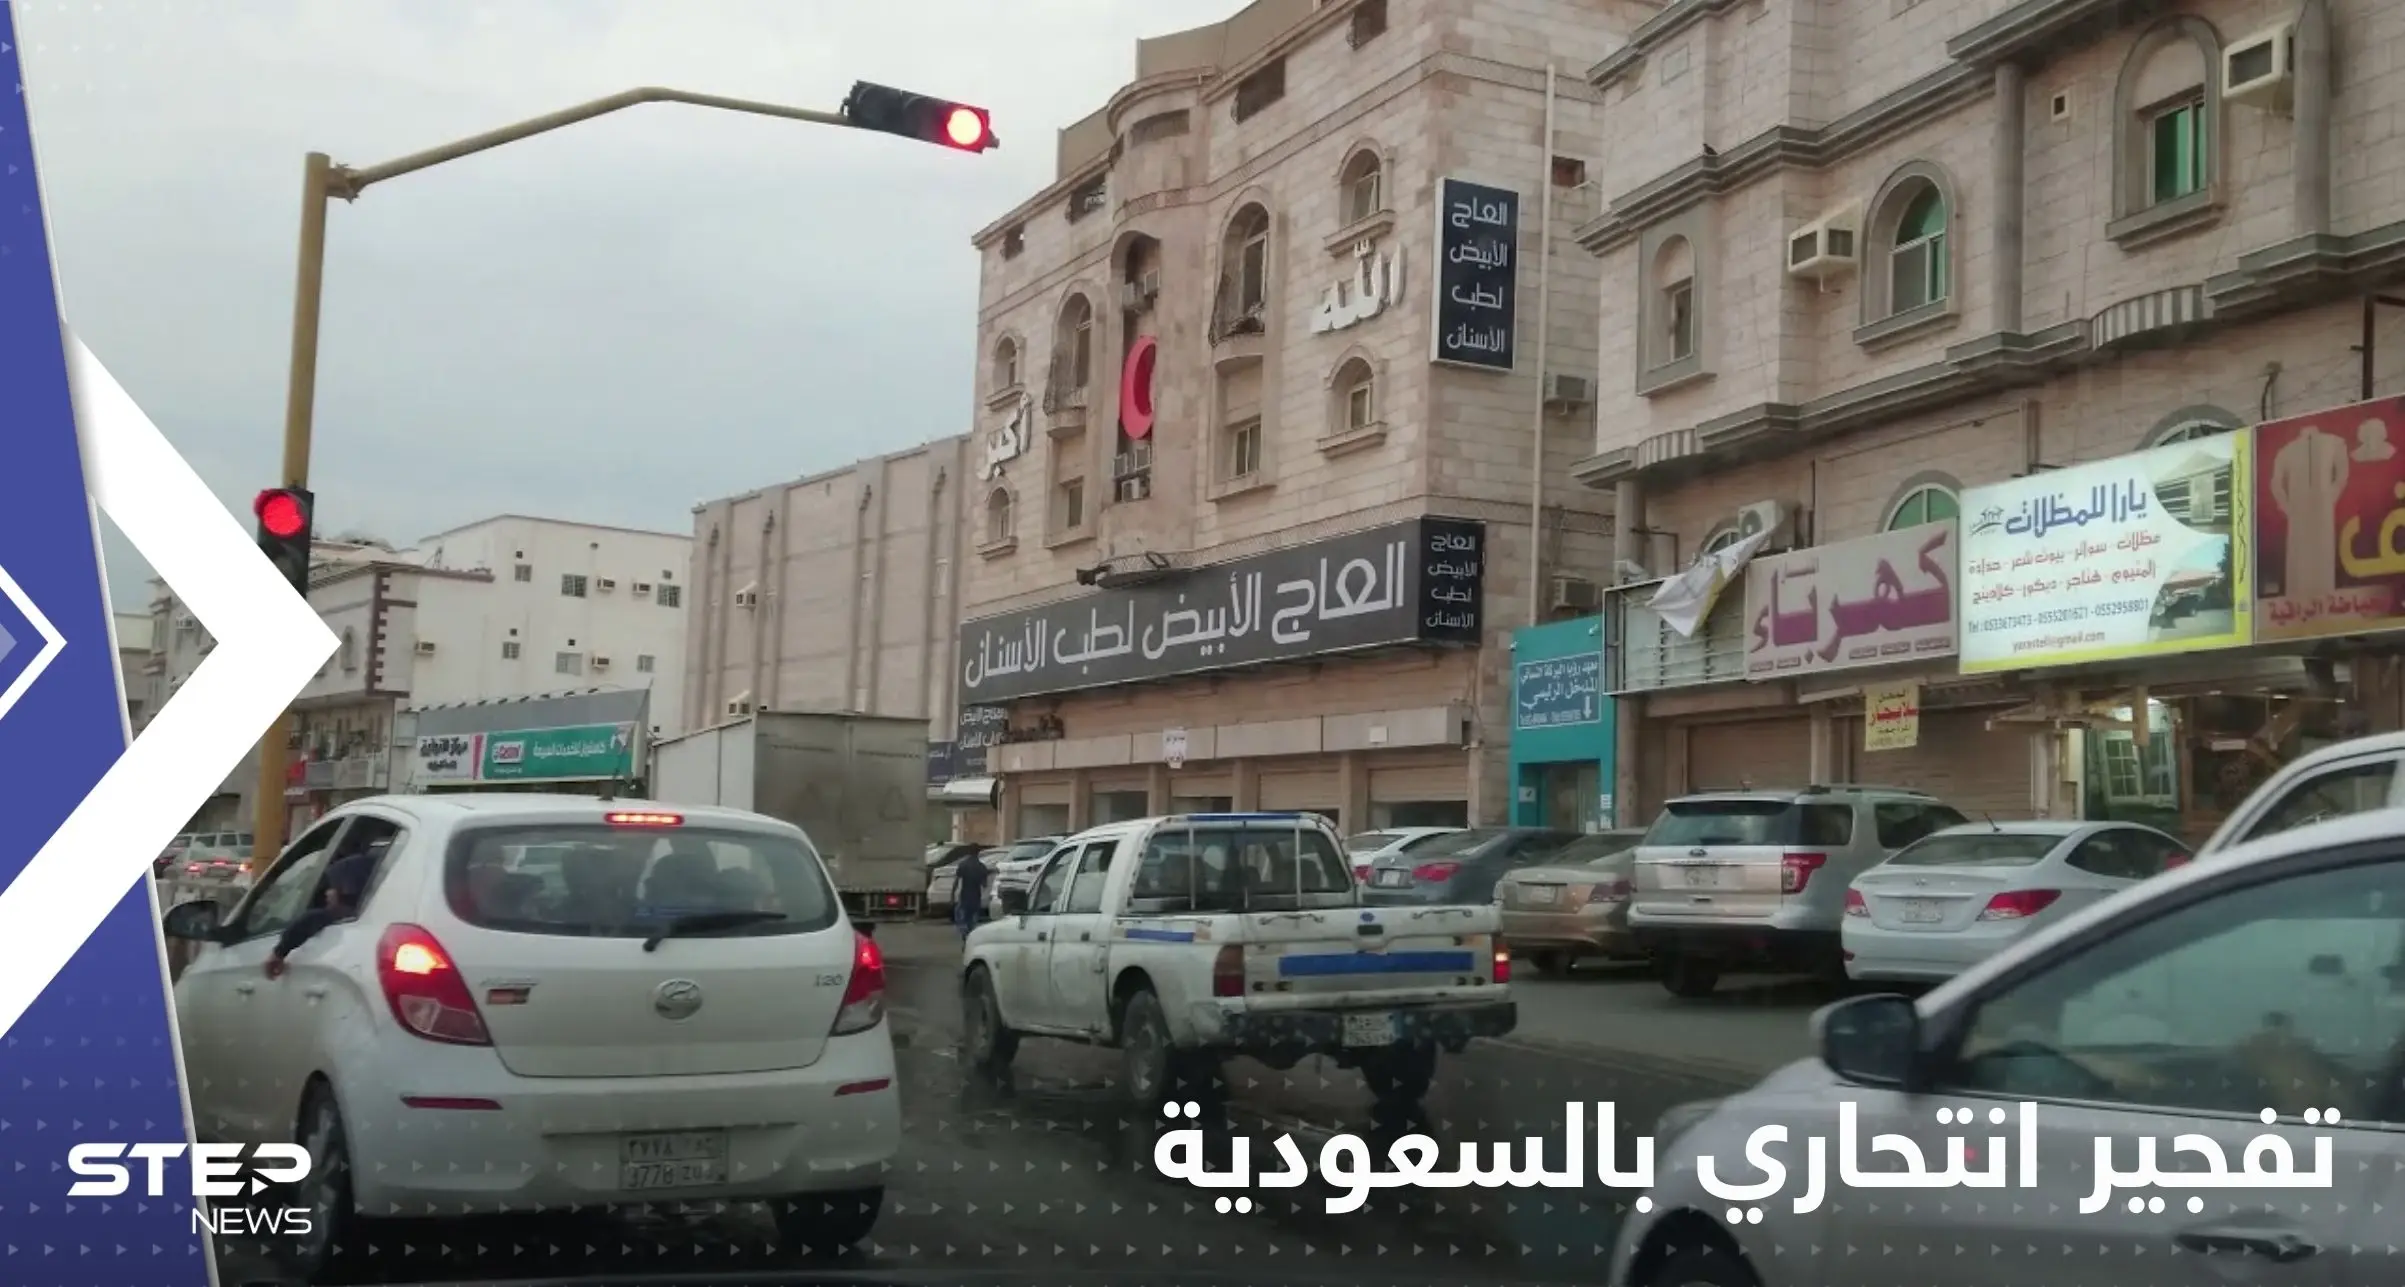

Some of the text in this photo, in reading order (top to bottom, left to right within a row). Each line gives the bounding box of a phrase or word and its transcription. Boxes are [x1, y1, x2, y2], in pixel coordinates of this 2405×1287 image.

[1452, 196, 1508, 229] العاج
[1452, 282, 1503, 311] لطب
[2005, 485, 2107, 539] للمظلات
[2110, 478, 2148, 523] يارا
[1430, 533, 1475, 552] العاج
[1431, 585, 1472, 604] لطب
[964, 541, 1406, 688] العاج الأبيض لطب الأسنان
